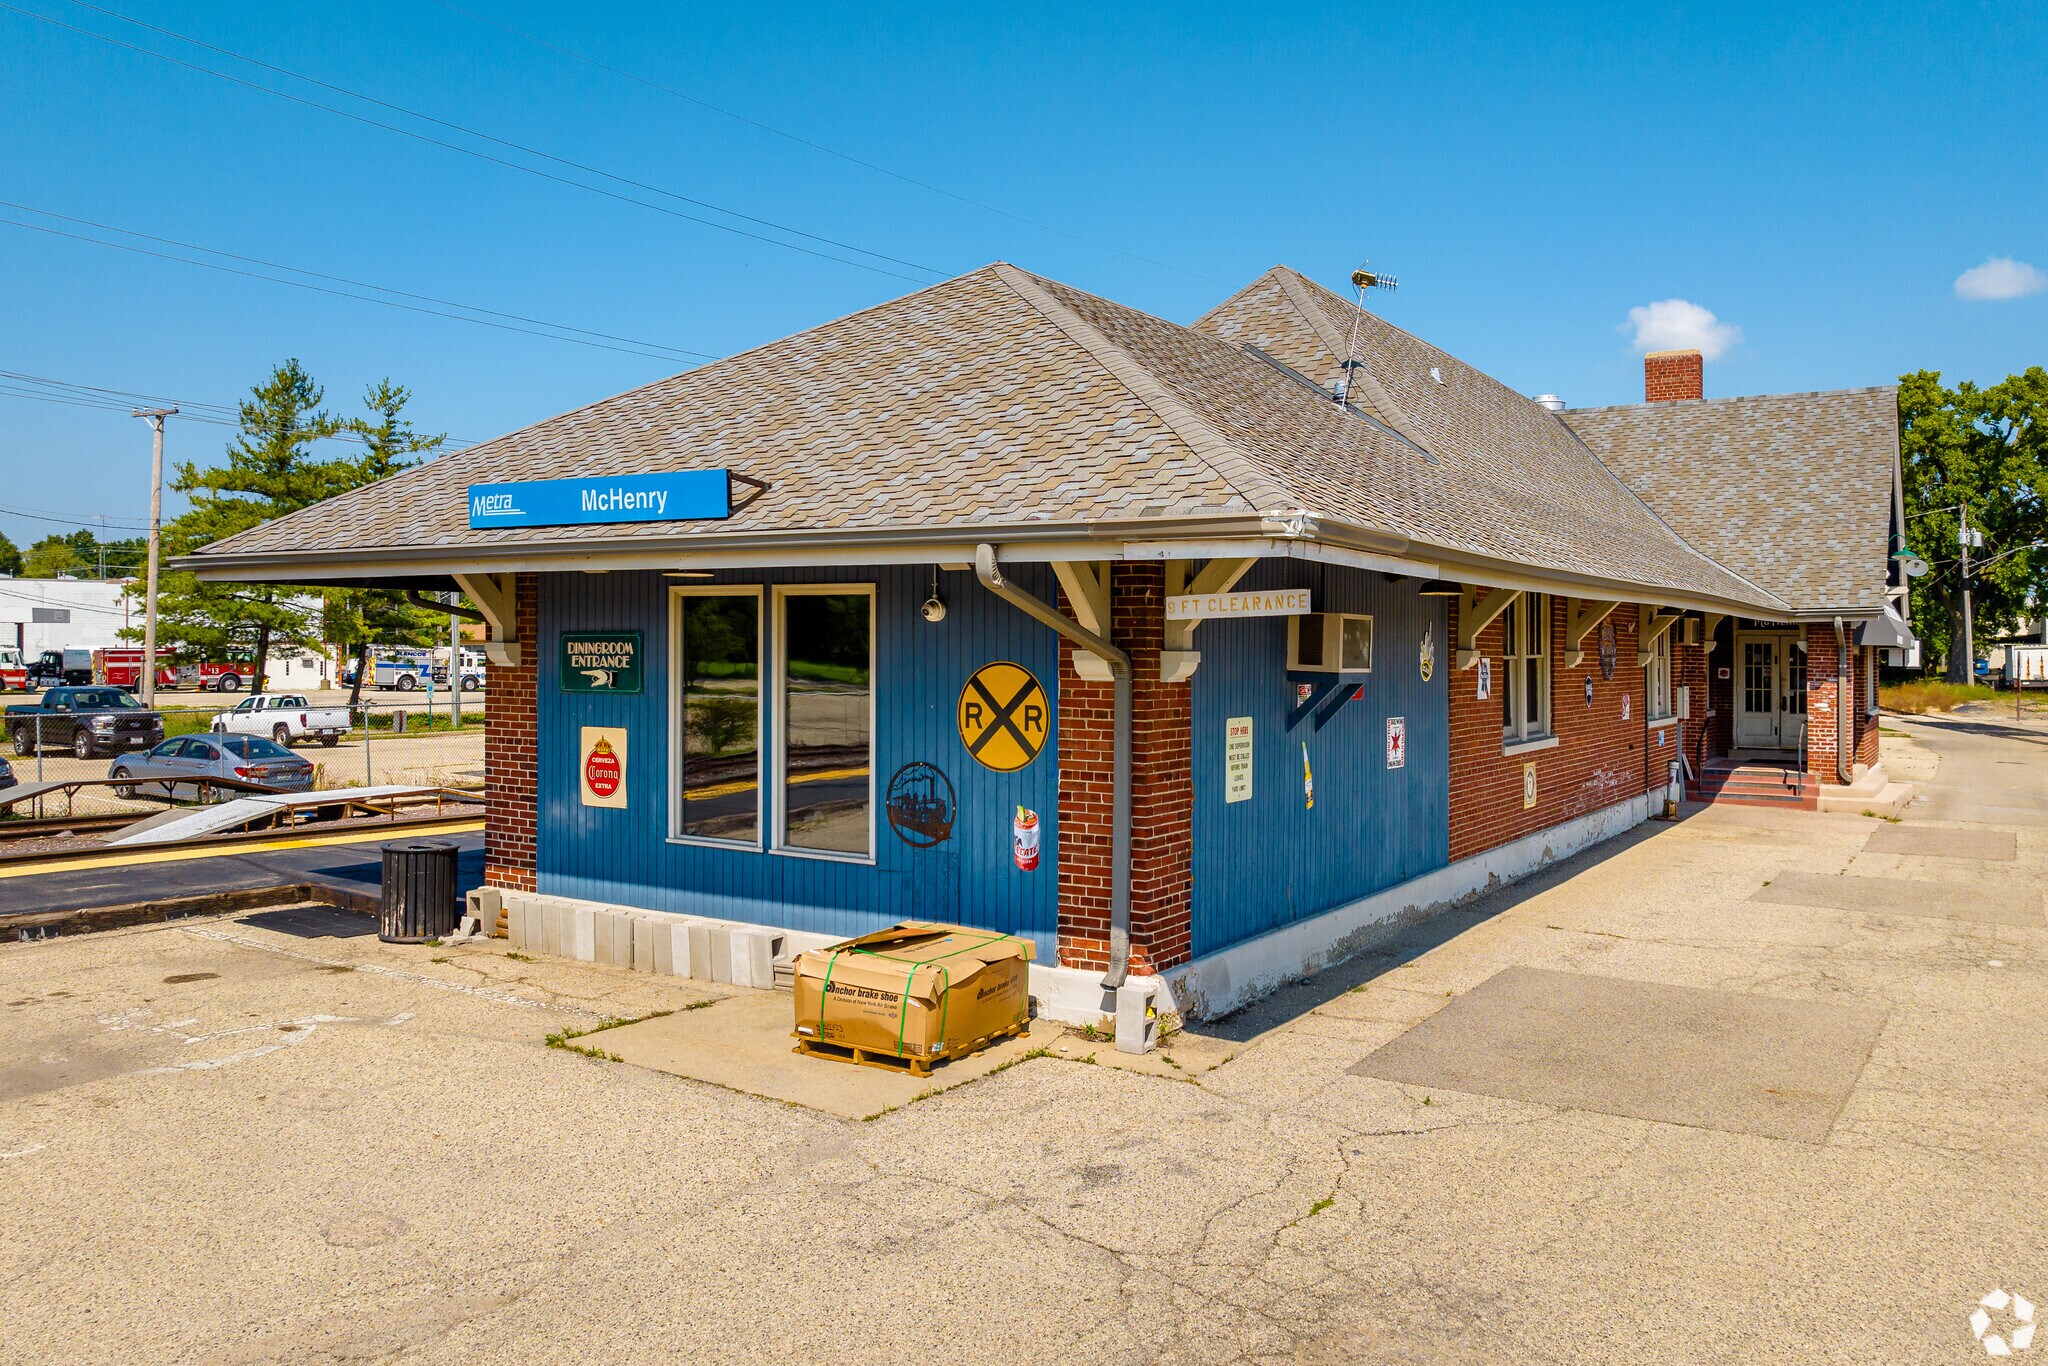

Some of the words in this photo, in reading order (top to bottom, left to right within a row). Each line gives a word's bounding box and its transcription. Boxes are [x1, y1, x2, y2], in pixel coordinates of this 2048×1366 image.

[472, 493, 512, 517] Metra
[581, 488, 668, 515] McHenry
[1167, 601, 1176, 614] 9
[1181, 600, 1200, 614] FT
[1207, 593, 1308, 612] CLEARANCE
[567, 641, 634, 655] DININGROOM
[571, 655, 630, 668] ENTRANCE
[965, 702, 983, 729] R
[1024, 705, 1043, 732] R
[1230, 727, 1239, 736] STOP
[1240, 726, 1249, 735] HERE
[588, 765, 619, 780] Corona
[857, 988, 879, 1000] brake
[880, 992, 899, 1003] shoe
